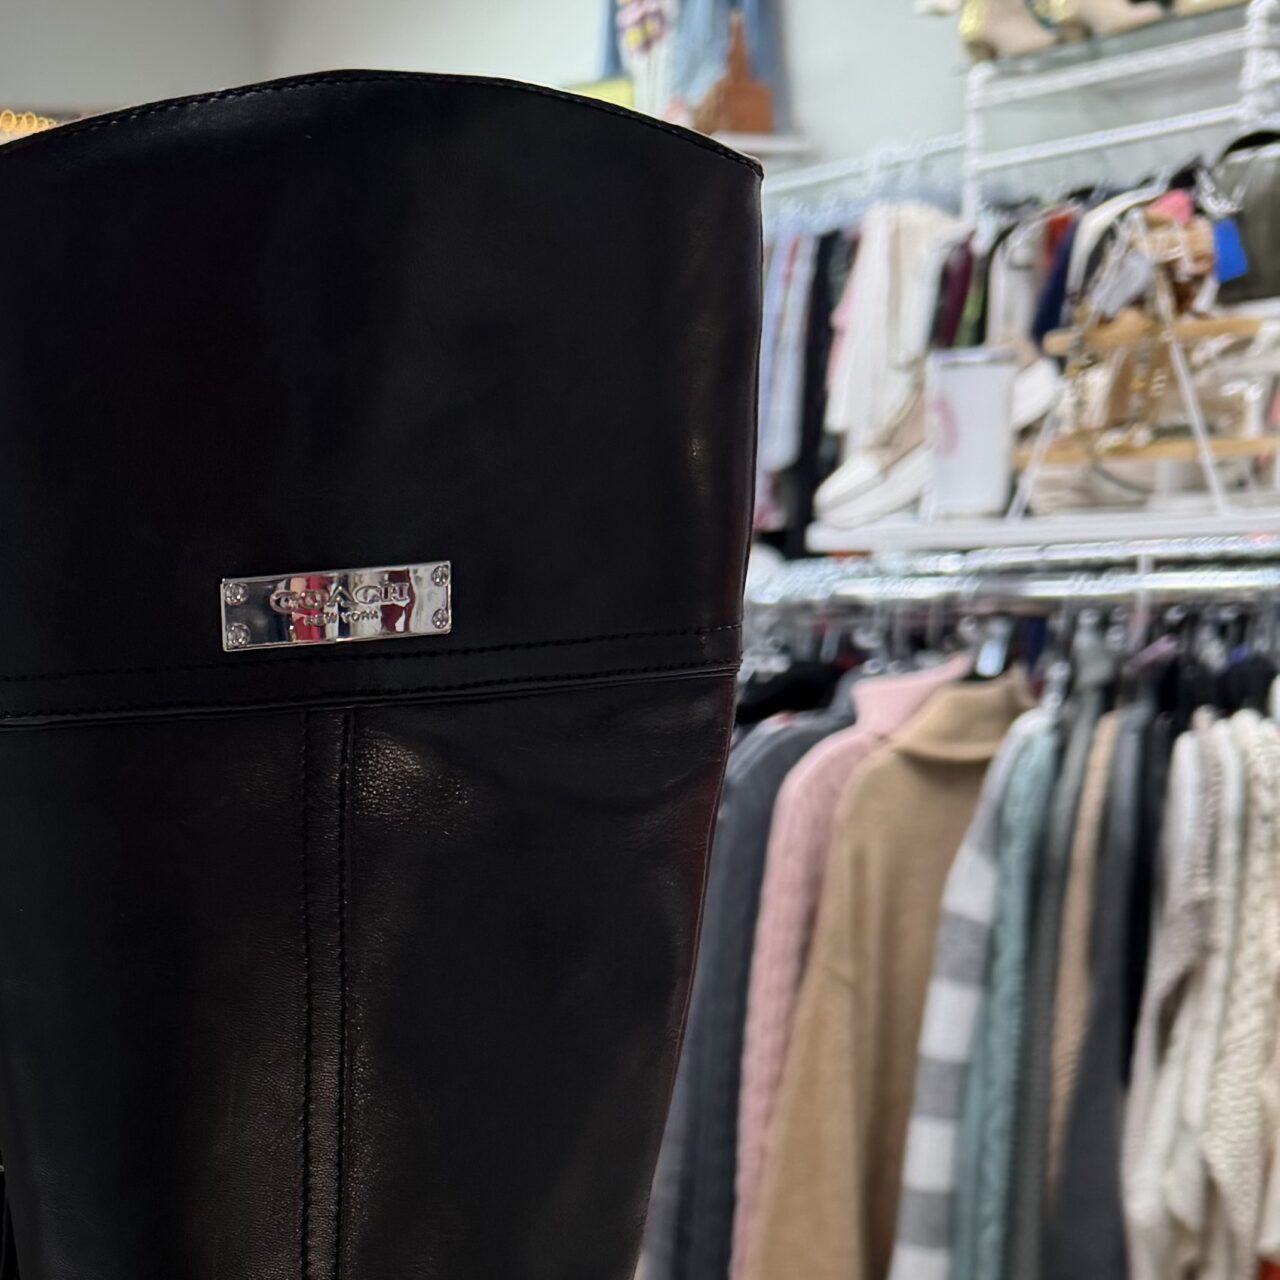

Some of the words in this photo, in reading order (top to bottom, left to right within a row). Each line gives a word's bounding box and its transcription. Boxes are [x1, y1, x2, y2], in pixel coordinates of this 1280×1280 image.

[269, 582, 410, 615] COACH
[304, 611, 338, 626] NEW
[341, 609, 380, 623] YORK
